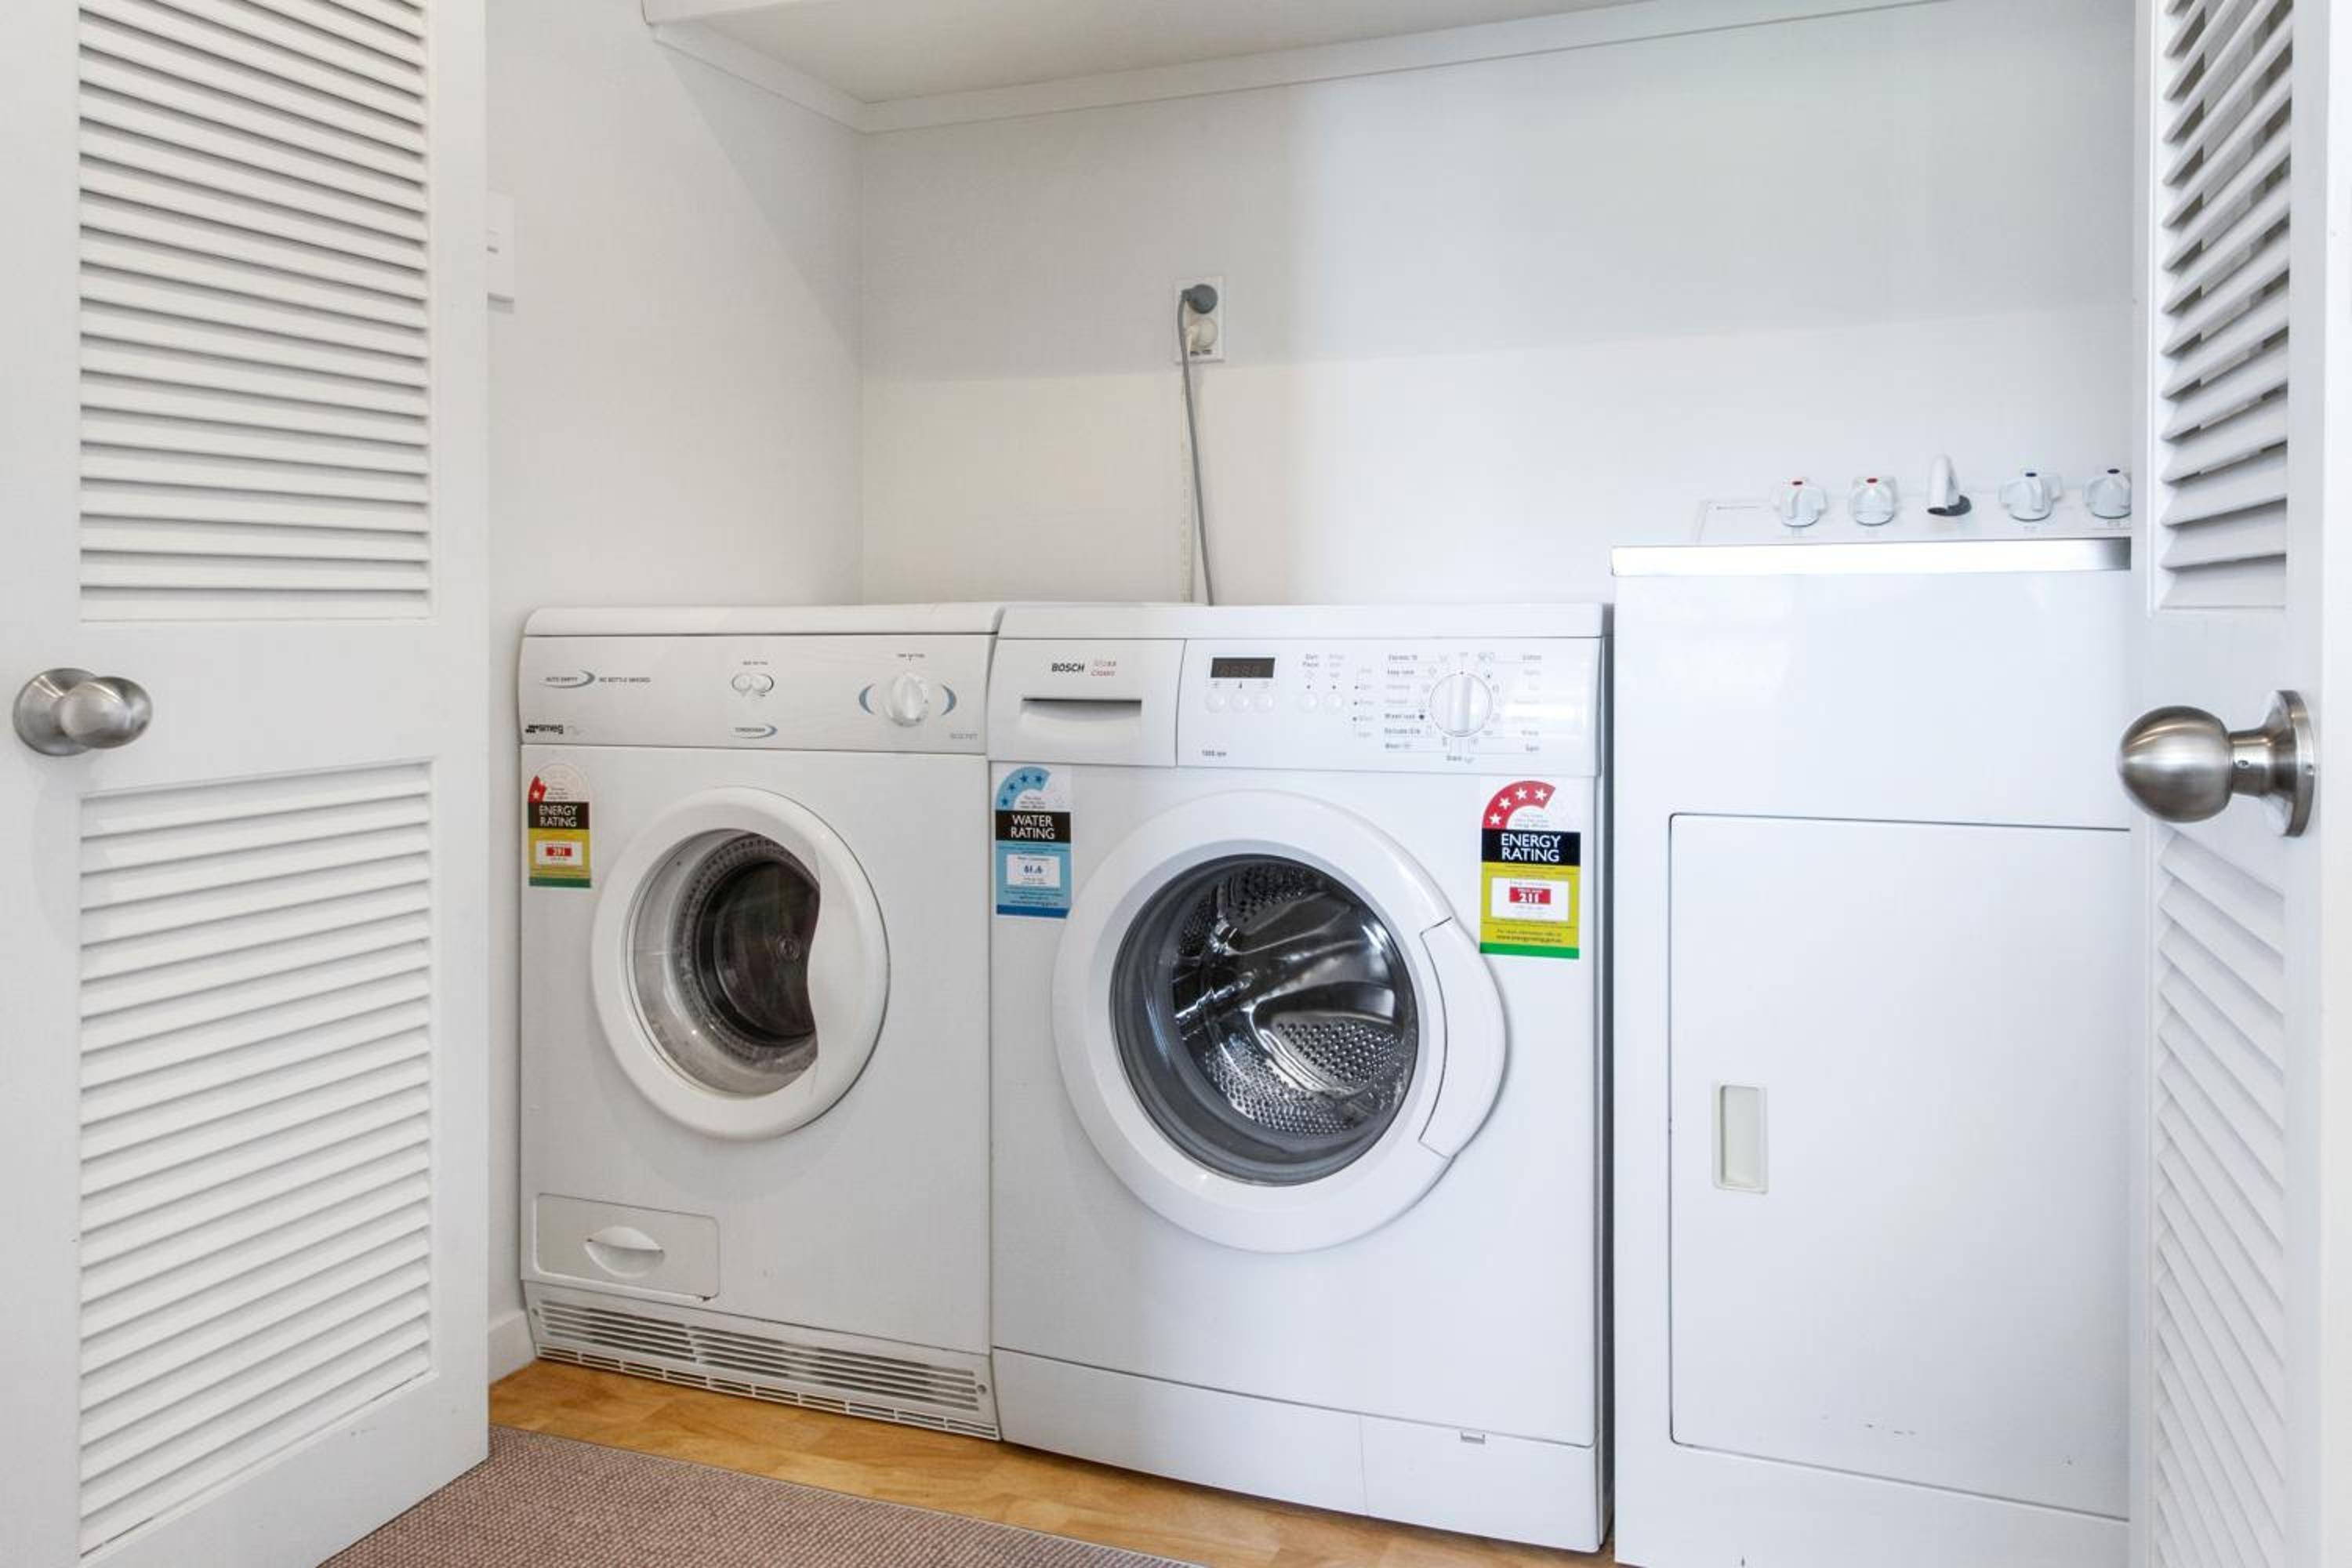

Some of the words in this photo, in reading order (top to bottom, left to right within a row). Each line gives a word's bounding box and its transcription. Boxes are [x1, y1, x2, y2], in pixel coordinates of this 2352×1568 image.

[1051, 662, 1085, 673] BOSCH
[539, 805, 578, 816] ENERGY
[539, 817, 577, 827] RATING
[1012, 815, 1054, 827] WATER
[1011, 827, 1055, 840] RATING
[1501, 833, 1561, 848] ENERGY
[1501, 848, 1560, 862] RATING
